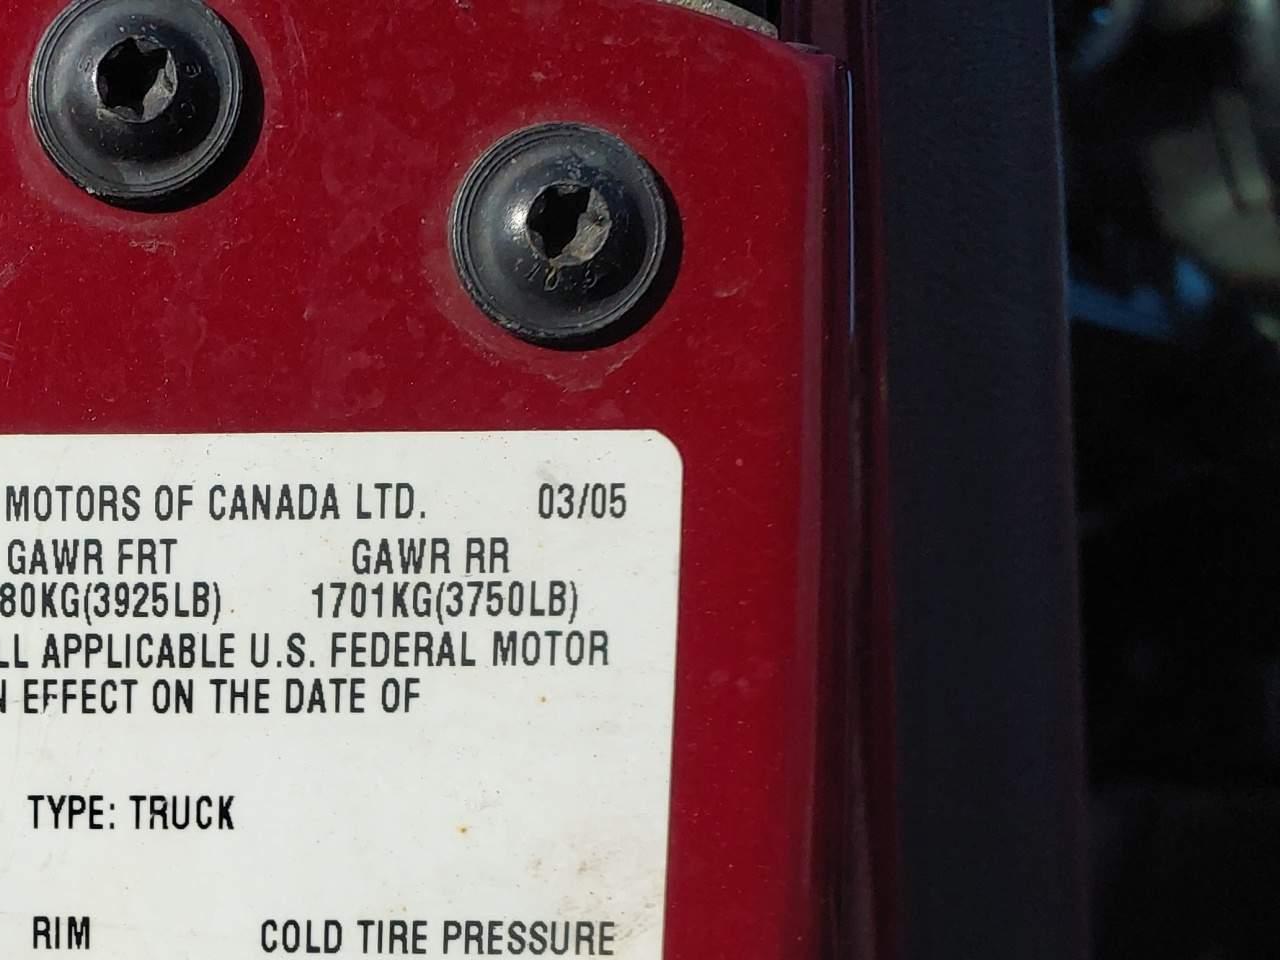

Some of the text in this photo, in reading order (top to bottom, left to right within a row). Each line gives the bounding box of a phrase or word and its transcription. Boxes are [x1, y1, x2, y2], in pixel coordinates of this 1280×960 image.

[6, 485, 140, 521] MOTORS
[155, 485, 193, 521] OF
[209, 483, 340, 520] CANADA
[357, 483, 425, 519] LTD.
[539, 483, 626, 519] 03/05
[8, 539, 177, 575] GAWR FRT
[352, 537, 509, 574] GAWR RR
[312, 581, 578, 625] 1701KG(3750LB)
[42, 633, 235, 668] APPLICABLE
[251, 633, 314, 668] U.S.
[331, 631, 475, 667] FEDERAL
[493, 631, 608, 666] MOTOR
[24, 679, 138, 714] EFFECT
[153, 679, 193, 714] ON
[210, 679, 270, 713] THE
[286, 678, 365, 713] DATE
[382, 678, 420, 713] OF
[27, 795, 234, 830] TYPE: TRUCK
[33, 916, 90, 949] RIM
[261, 919, 615, 955] COLD TIRE PRESSURE
